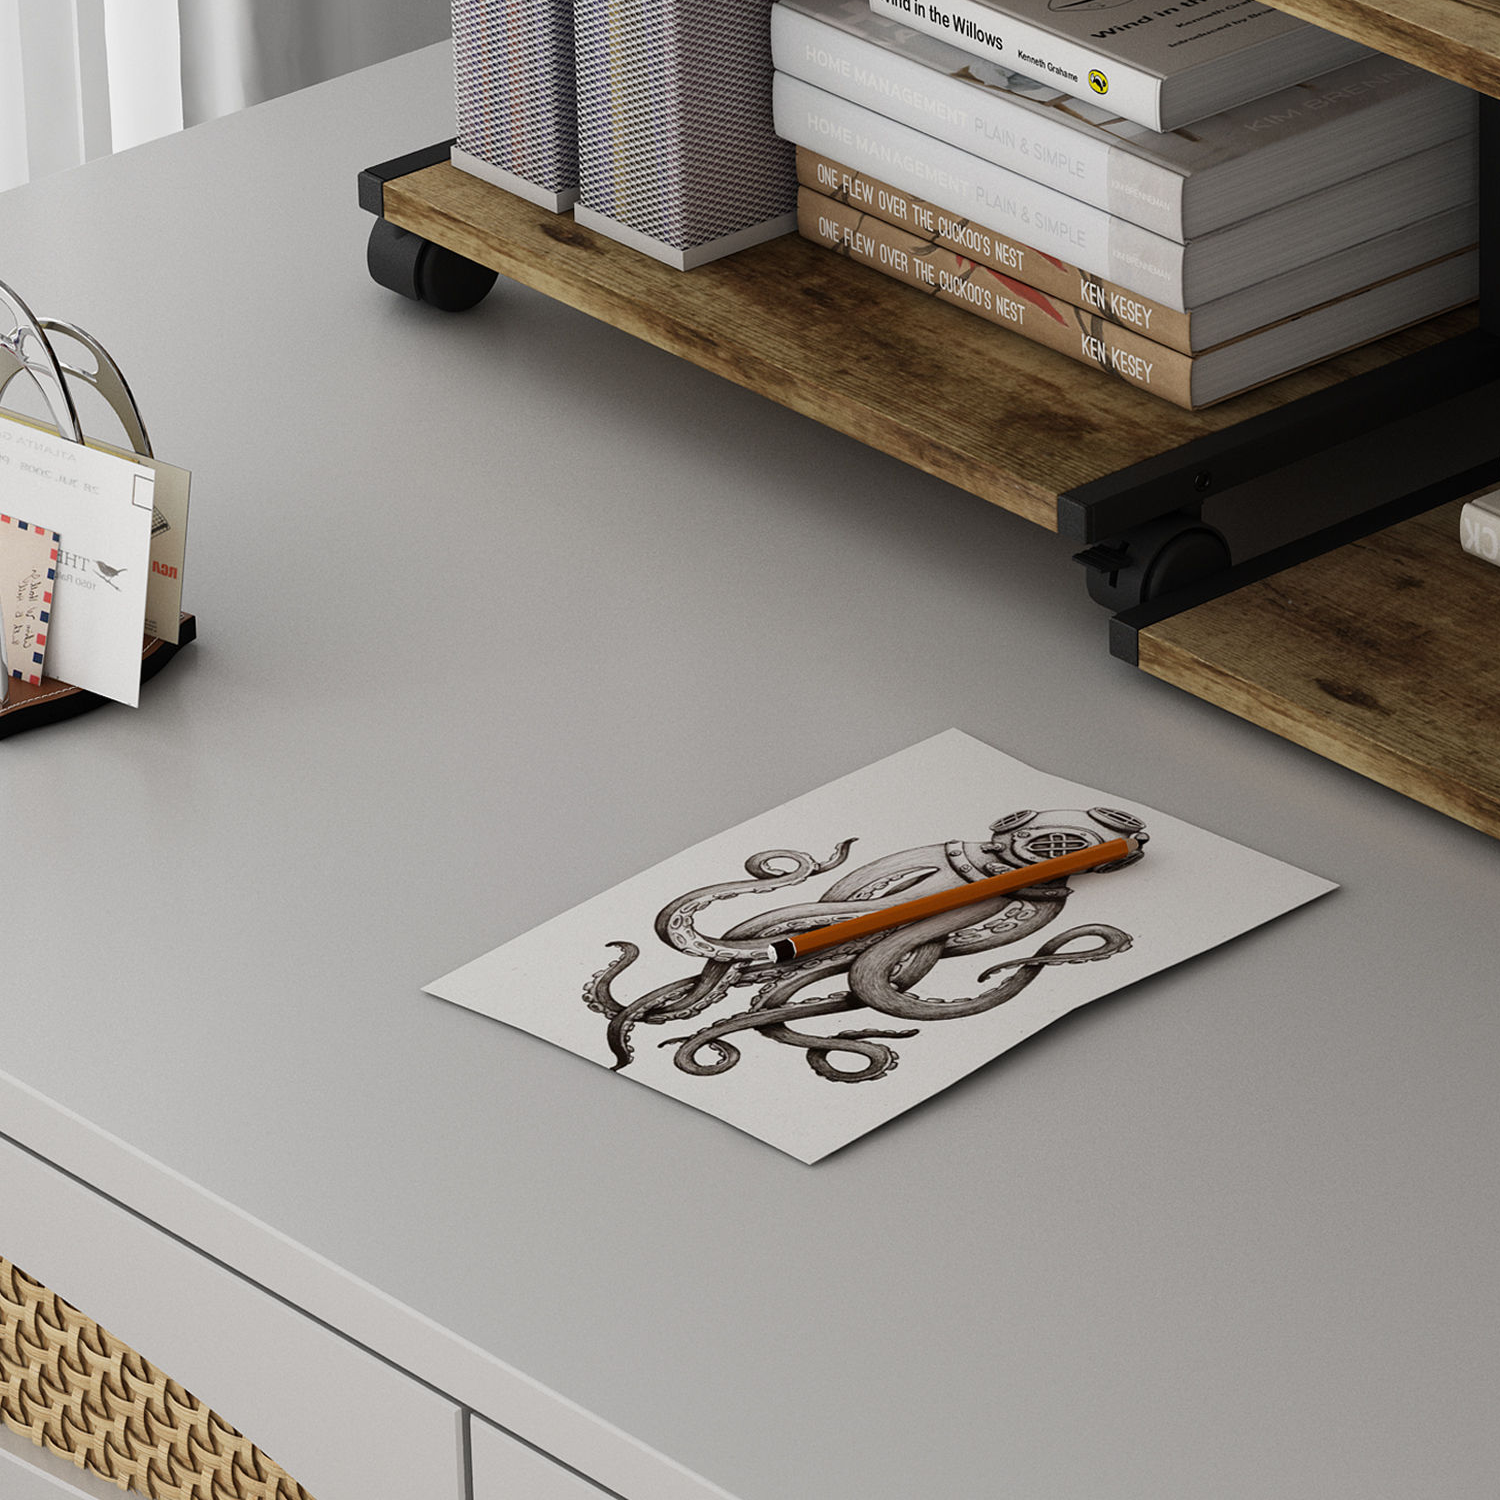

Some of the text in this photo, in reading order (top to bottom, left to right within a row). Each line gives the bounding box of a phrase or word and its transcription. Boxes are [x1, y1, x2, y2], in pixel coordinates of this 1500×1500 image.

[929, 4, 950, 29] the
[952, 13, 1004, 51] Willows
[1090, 15, 1154, 40] Wind
[1153, 6, 1180, 18] in
[1167, 17, 1248, 49] Introduced by
[1175, 7, 1226, 29] Kenneth
[1017, 49, 1079, 84] Kenneth Grahame
[805, 44, 851, 78] HOME
[853, 58, 969, 129] MANAGEMENT
[973, 116, 1017, 150] PLAIN
[1019, 137, 1031, 154] &
[1033, 141, 1086, 180] SIMPLE
[1124, 183, 1171, 213] BRENNEMAN
[1244, 107, 1303, 133] KIM
[807, 111, 852, 145] HOME
[855, 127, 970, 199] MANAGEMENT
[975, 185, 1018, 219] PLAIN
[1020, 205, 1032, 224] &
[1033, 210, 1087, 249] SIMPLE
[1125, 252, 1173, 282] BRENNEMAN
[817, 163, 1025, 272] ONE FLEW OVER THE CUCKOO'S NEST
[818, 216, 1026, 326] ONE FLEW OVER THE CUCKOO'S NEST
[1080, 278, 1153, 331] KEN KESEY
[1081, 332, 1154, 386] KEN KESEY
